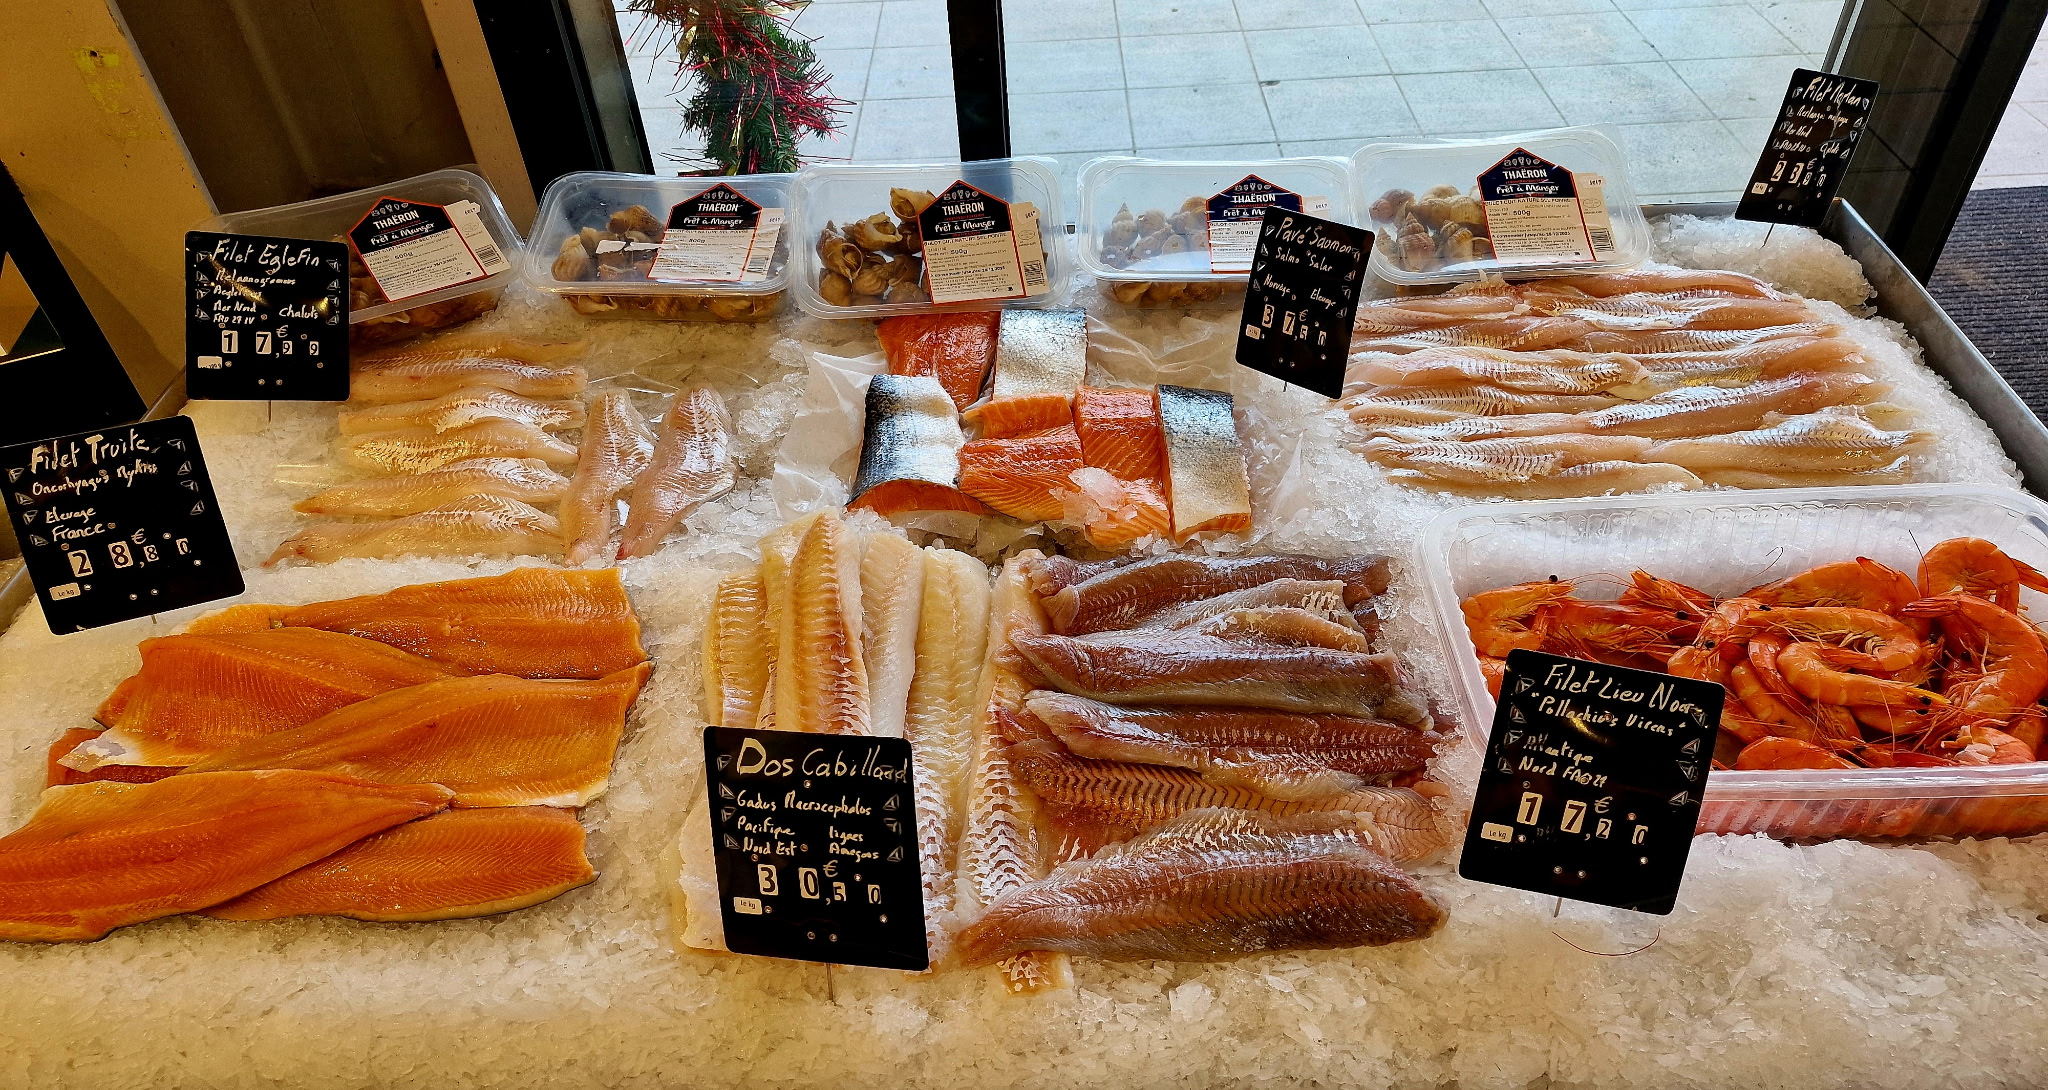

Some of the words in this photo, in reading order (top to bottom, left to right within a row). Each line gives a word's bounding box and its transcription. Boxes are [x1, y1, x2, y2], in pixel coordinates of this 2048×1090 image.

[1502, 169, 1547, 180] THAËRON
[1232, 194, 1276, 203] THAËRON
[1496, 185, 1513, 195] Prêt
[1525, 184, 1560, 194] Manger
[697, 203, 740, 212] THAËRON
[942, 202, 985, 216] THAËRON
[1223, 209, 1240, 217] Prêt
[372, 210, 420, 230] THAËRON
[683, 217, 700, 225] Prêt
[709, 217, 744, 227] Manger
[935, 222, 951, 233] Prêt
[954, 221, 961, 230] à
[962, 219, 996, 231] Manger
[370, 234, 389, 246] Prêt
[391, 231, 399, 240] à
[400, 222, 435, 239] Manger
[1275, 216, 1312, 245] Pavé
[1309, 224, 1352, 254] Saumon
[212, 238, 254, 264] Filet
[1275, 246, 1300, 264] Salmo
[1309, 254, 1333, 272] Salar
[233, 300, 257, 313] Nord
[30, 440, 80, 474] Filet
[85, 428, 150, 464] Truite
[45, 506, 97, 524] Elevage
[51, 523, 106, 543] France
[1543, 663, 1600, 693] Filet
[1597, 677, 1645, 703] Lieu
[736, 737, 794, 778] Dos
[1518, 755, 1558, 776] Nord
[737, 789, 777, 812] Gadus
[737, 815, 796, 840] Pacifique
[742, 836, 771, 855] Nord
[775, 840, 798, 857] Est
